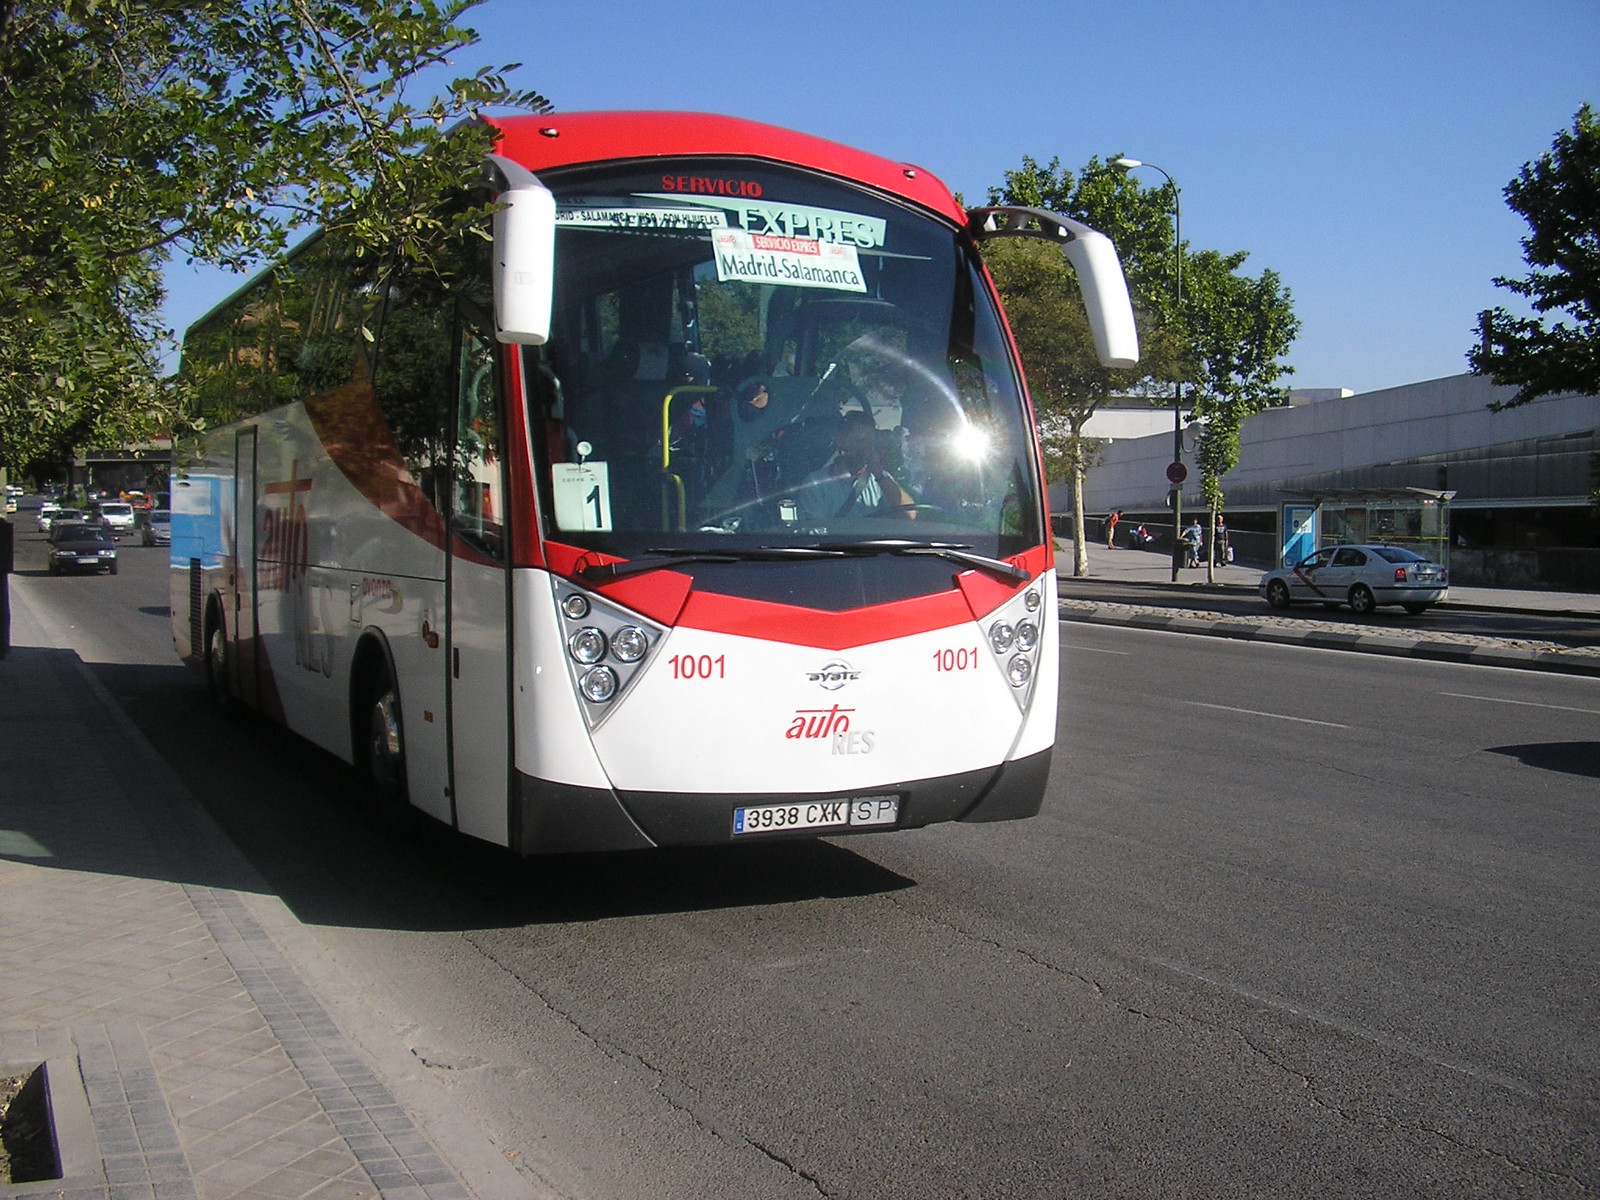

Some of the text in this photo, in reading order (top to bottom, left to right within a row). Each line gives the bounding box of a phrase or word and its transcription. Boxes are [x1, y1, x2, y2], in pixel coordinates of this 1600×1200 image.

[662, 175, 763, 198] SERVICIO
[555, 211, 574, 221] DRID
[738, 207, 876, 249] EXPRES
[756, 235, 791, 251] SERVICIO
[722, 253, 860, 286] Madrid-Salamanca
[586, 484, 603, 529] 1
[668, 654, 726, 680] 1001
[932, 647, 978, 672] 1001
[785, 704, 856, 739] auto
[832, 731, 875, 755] RES
[748, 802, 844, 829] 3938 CXK
